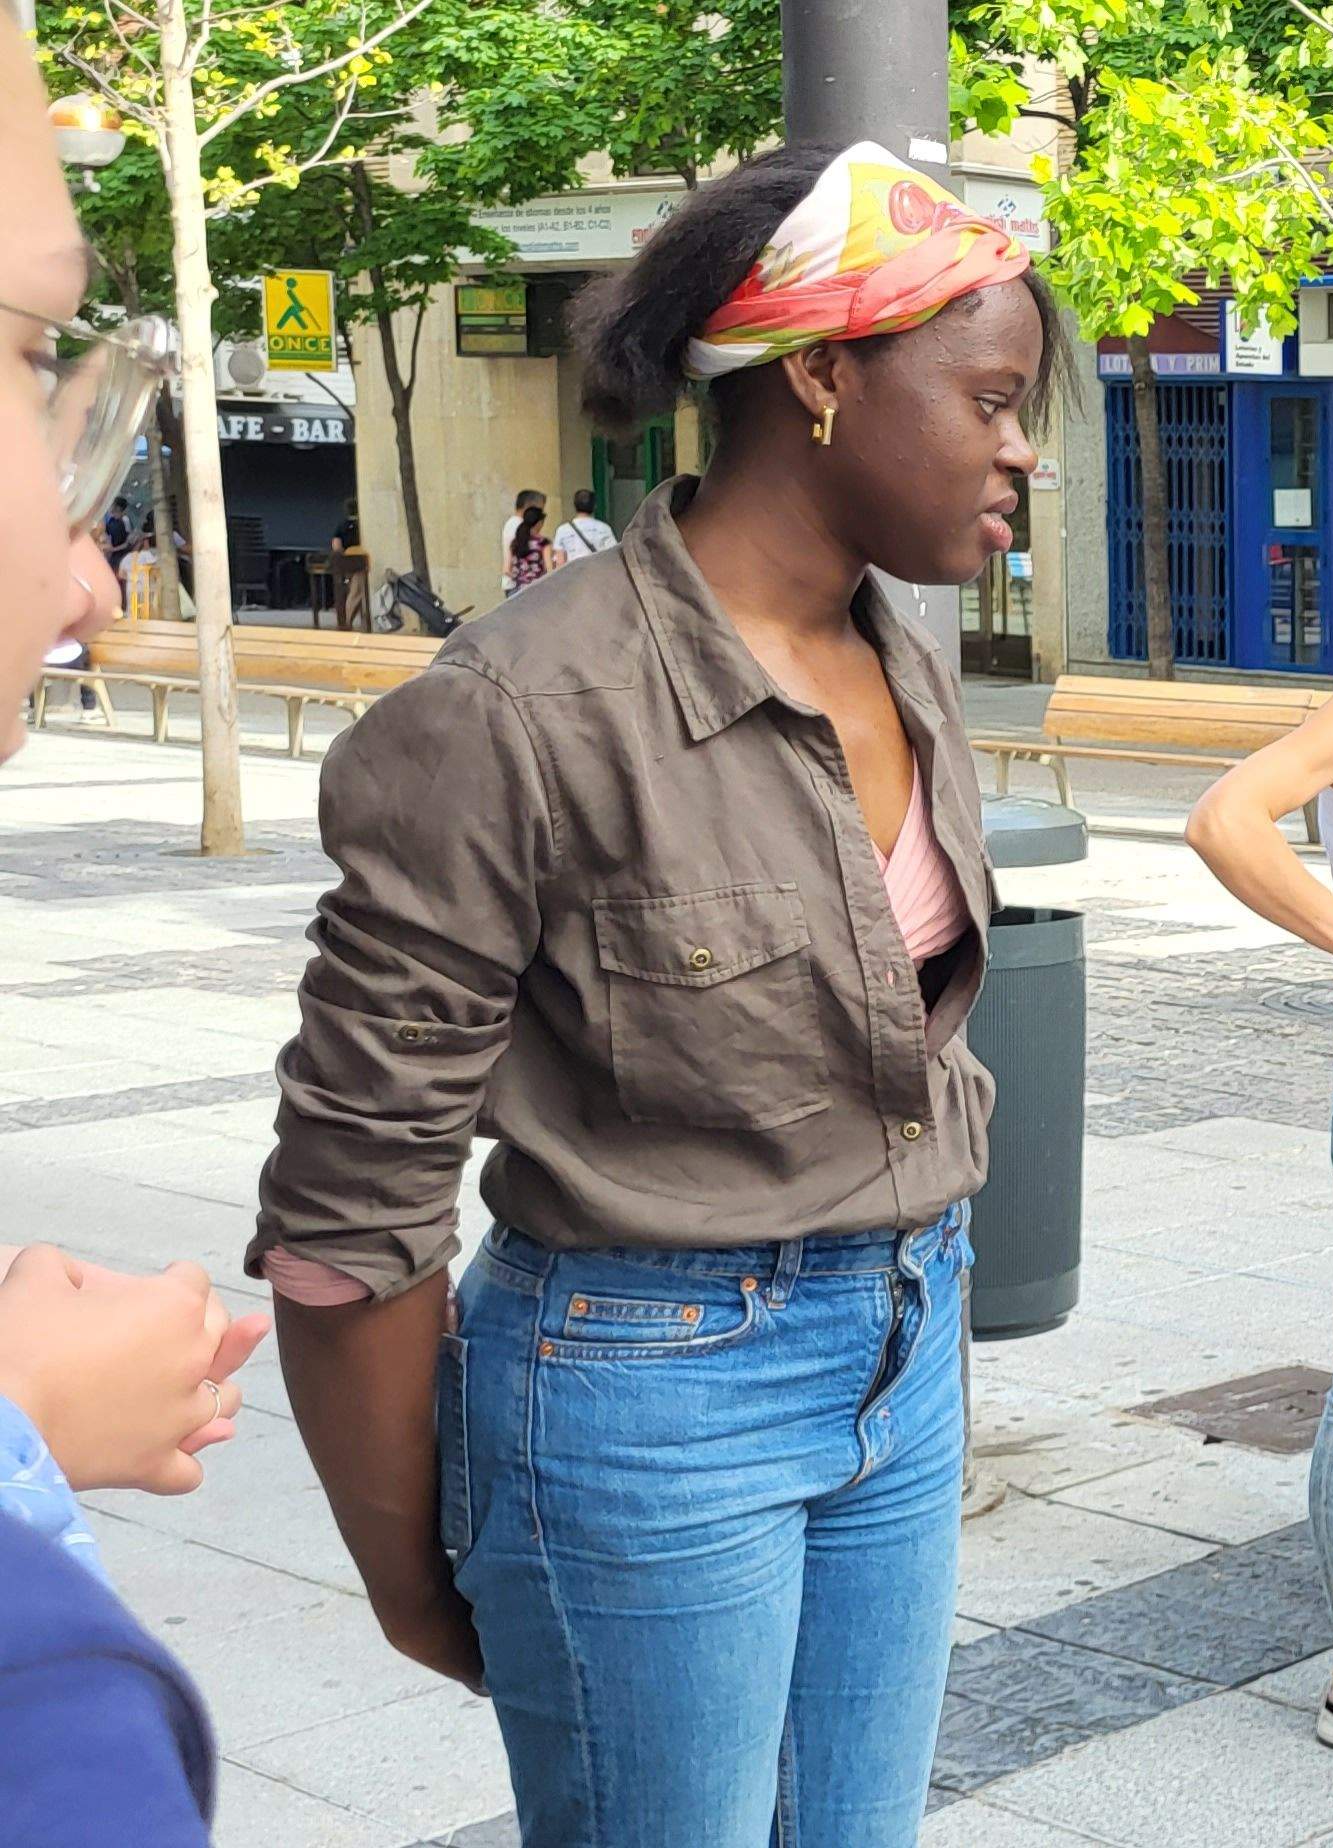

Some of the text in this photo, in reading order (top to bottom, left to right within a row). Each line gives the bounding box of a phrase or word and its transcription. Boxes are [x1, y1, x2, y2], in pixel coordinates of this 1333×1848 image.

[269, 337, 331, 351] ONCE
[217, 416, 264, 441] AFE
[291, 418, 347, 443] BAR
